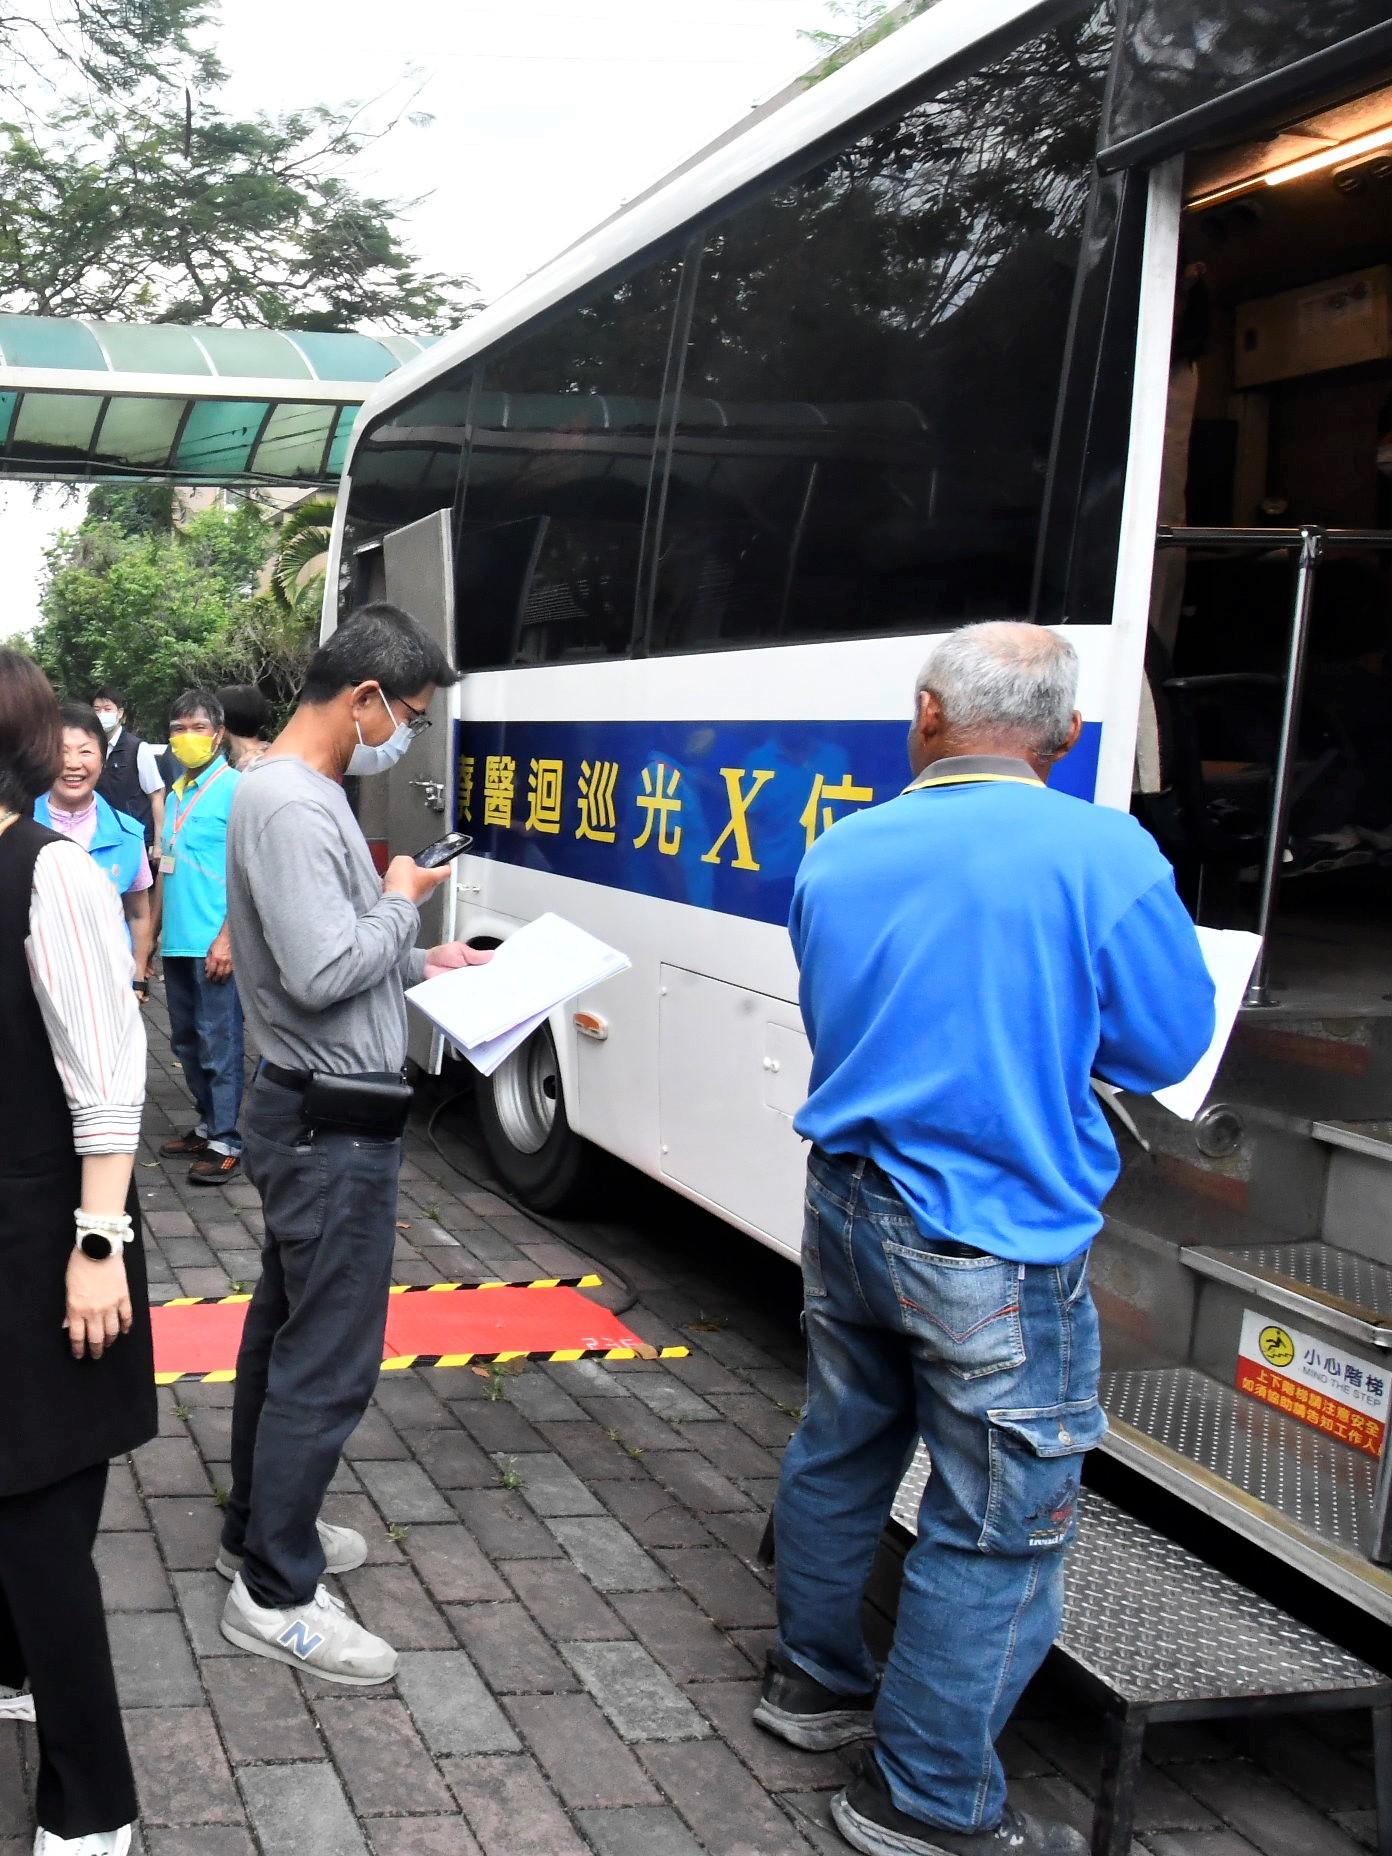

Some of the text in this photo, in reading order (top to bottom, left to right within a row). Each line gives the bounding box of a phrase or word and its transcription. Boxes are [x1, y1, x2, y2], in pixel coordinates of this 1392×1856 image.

[1302, 1367, 1382, 1408] MIND THE STEP
[1303, 1348, 1384, 1397] 小心階梯
[276, 1619, 326, 1660] N
